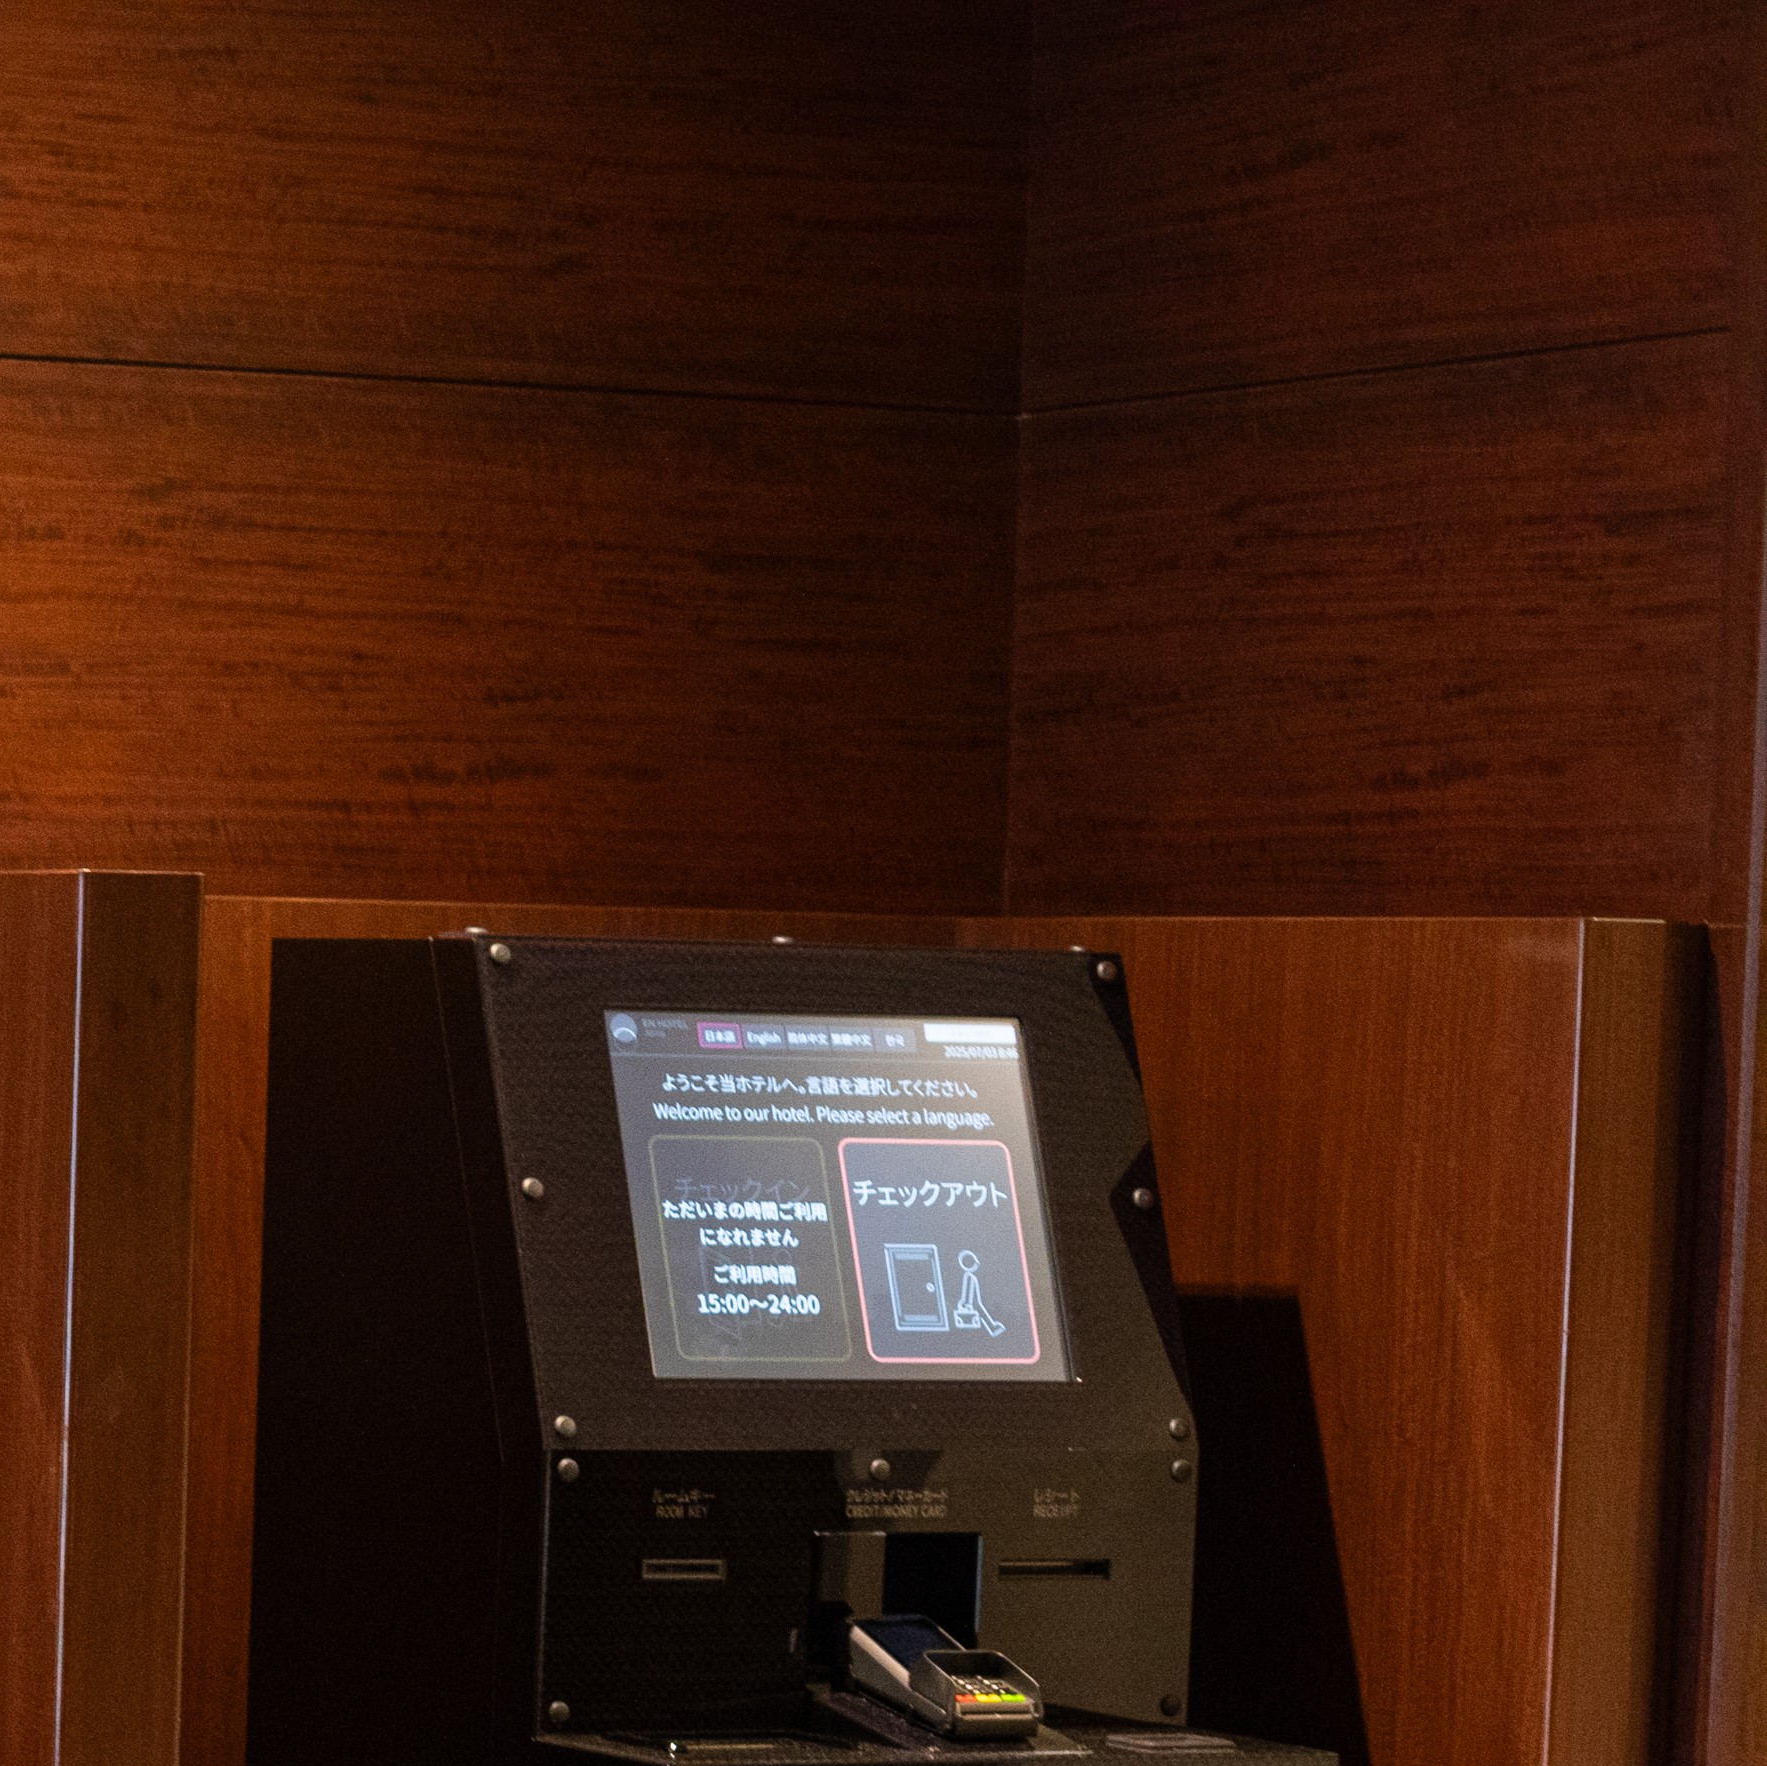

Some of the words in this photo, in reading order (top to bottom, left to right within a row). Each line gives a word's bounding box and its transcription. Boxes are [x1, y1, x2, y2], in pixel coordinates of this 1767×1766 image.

[704, 1029, 736, 1043] 日本語
[746, 1030, 782, 1045] English
[662, 1072, 978, 1098] ようこそ当ホテルへ。言語を選択してください。
[652, 1102, 723, 1120] Welcome
[724, 1104, 742, 1120] to
[744, 1107, 769, 1121] our
[771, 1104, 814, 1123] hotel.
[816, 1105, 864, 1124] Please
[866, 1106, 908, 1125] select
[911, 1111, 922, 1125] a
[923, 1108, 995, 1130] language.
[852, 1180, 1008, 1208] チェックアウト
[662, 1199, 828, 1221] ただいまの時間ご利用
[699, 1226, 800, 1247] になれません
[714, 1264, 797, 1285] ご利用時間
